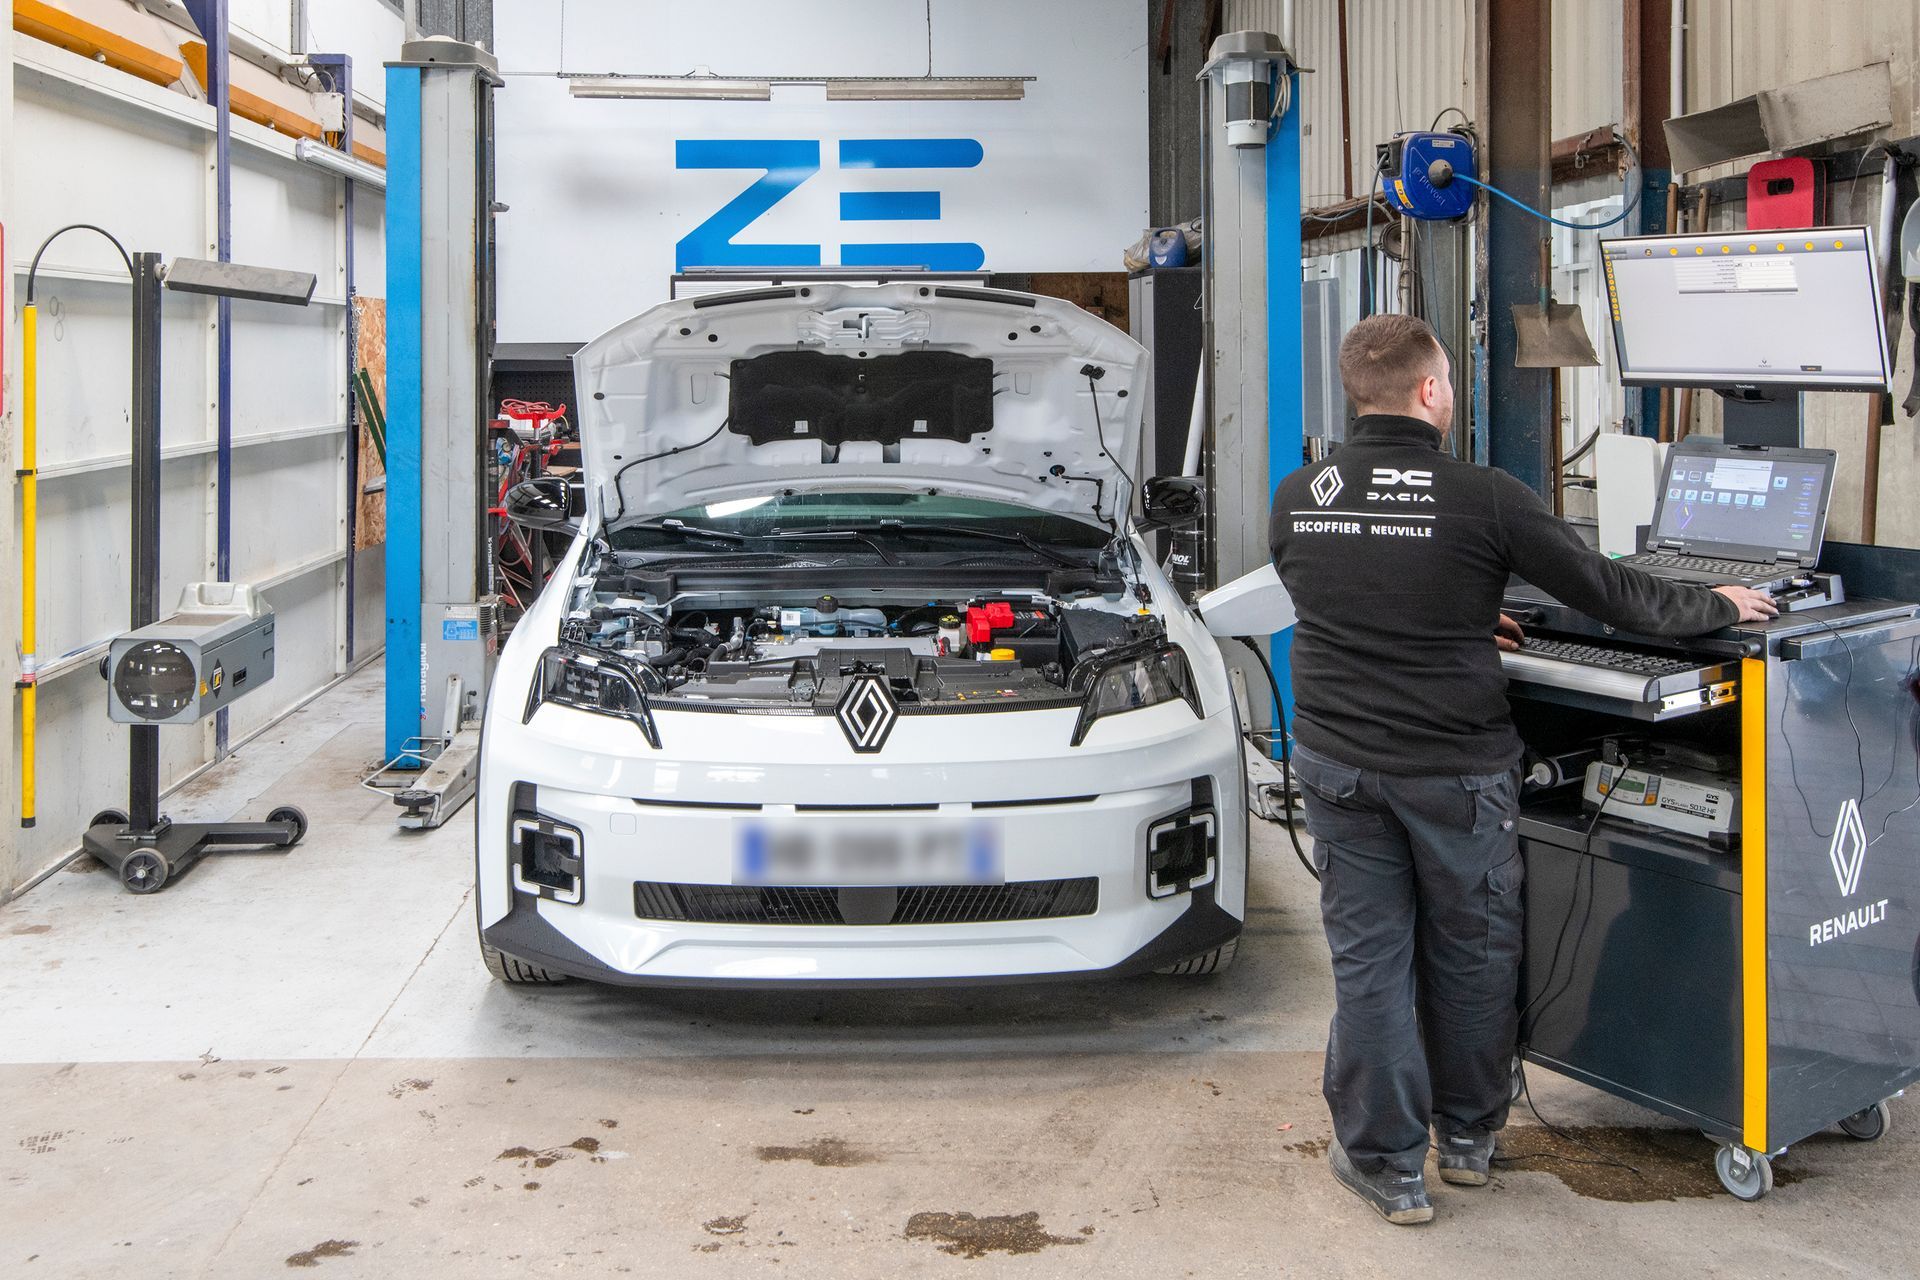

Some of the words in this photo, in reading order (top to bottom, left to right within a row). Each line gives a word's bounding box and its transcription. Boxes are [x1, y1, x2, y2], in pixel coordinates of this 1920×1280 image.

[675, 138, 985, 273] ZE
[1367, 492, 1435, 502] DACIA
[1293, 521, 1361, 534] ESCOFFIER
[1371, 525, 1431, 537] NEUVILLE
[1810, 898, 1889, 947] RENAULT
